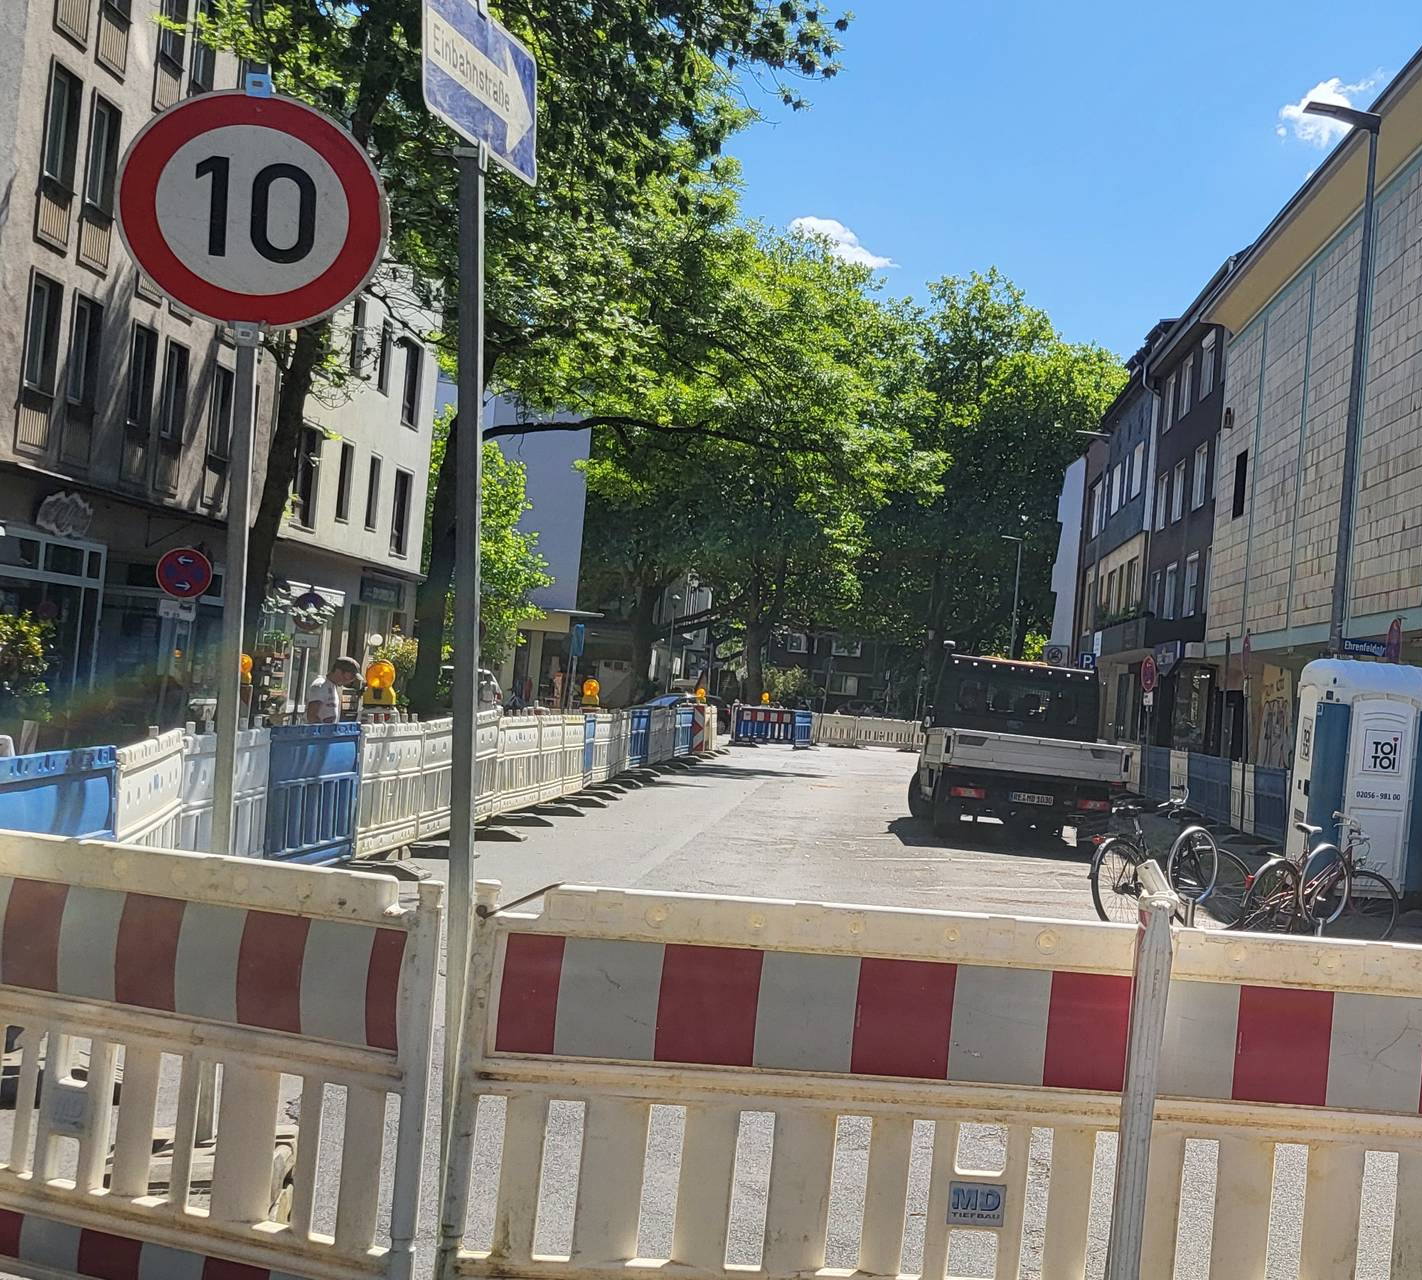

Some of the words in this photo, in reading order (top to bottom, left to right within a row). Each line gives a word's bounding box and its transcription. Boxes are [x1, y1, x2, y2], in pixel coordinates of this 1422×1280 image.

[433, 23, 510, 113] Einbahnstraße
[195, 156, 317, 264] 10
[1083, 655, 1093, 669] P
[1371, 755, 1396, 770] TOI
[951, 1187, 1001, 1211] MD
[951, 1212, 1000, 1220] TIEFBAU
